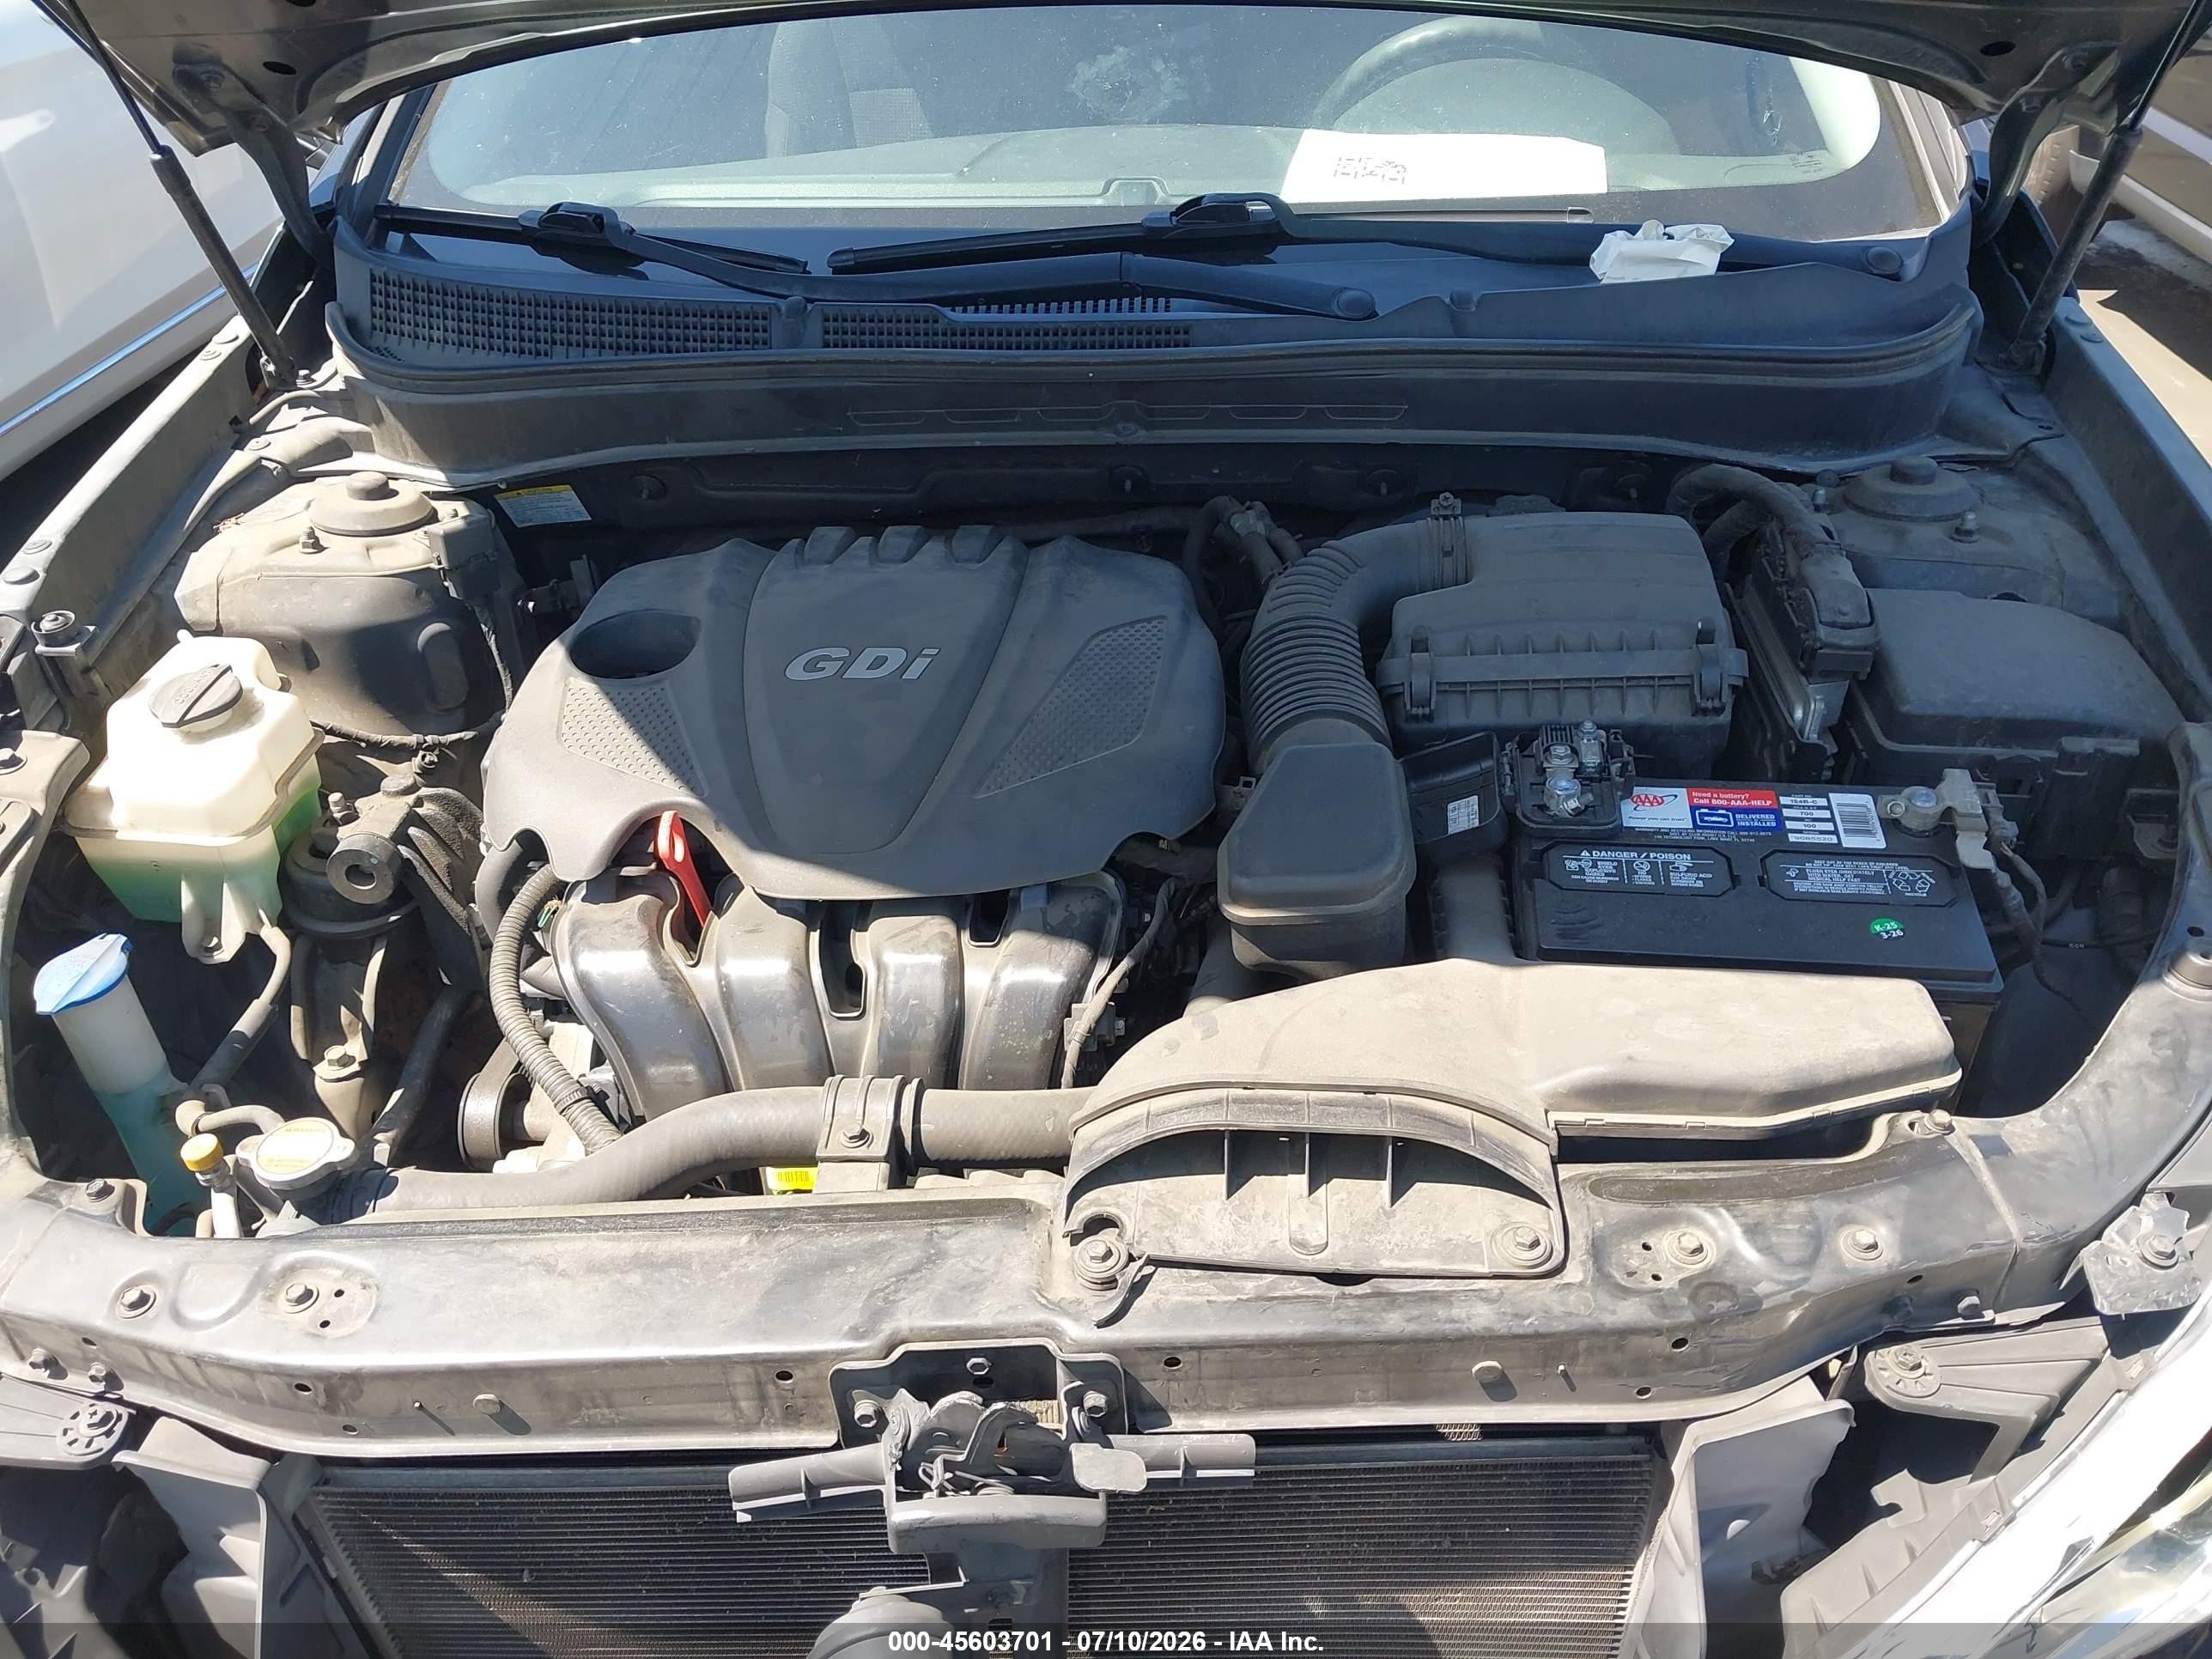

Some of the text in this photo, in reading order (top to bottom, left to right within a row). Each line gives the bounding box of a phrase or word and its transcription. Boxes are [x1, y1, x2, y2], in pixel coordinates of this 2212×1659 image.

[785, 647, 941, 681] GDi
[1633, 794, 1662, 806] AAA
[1881, 929, 1904, 939] 3-26
